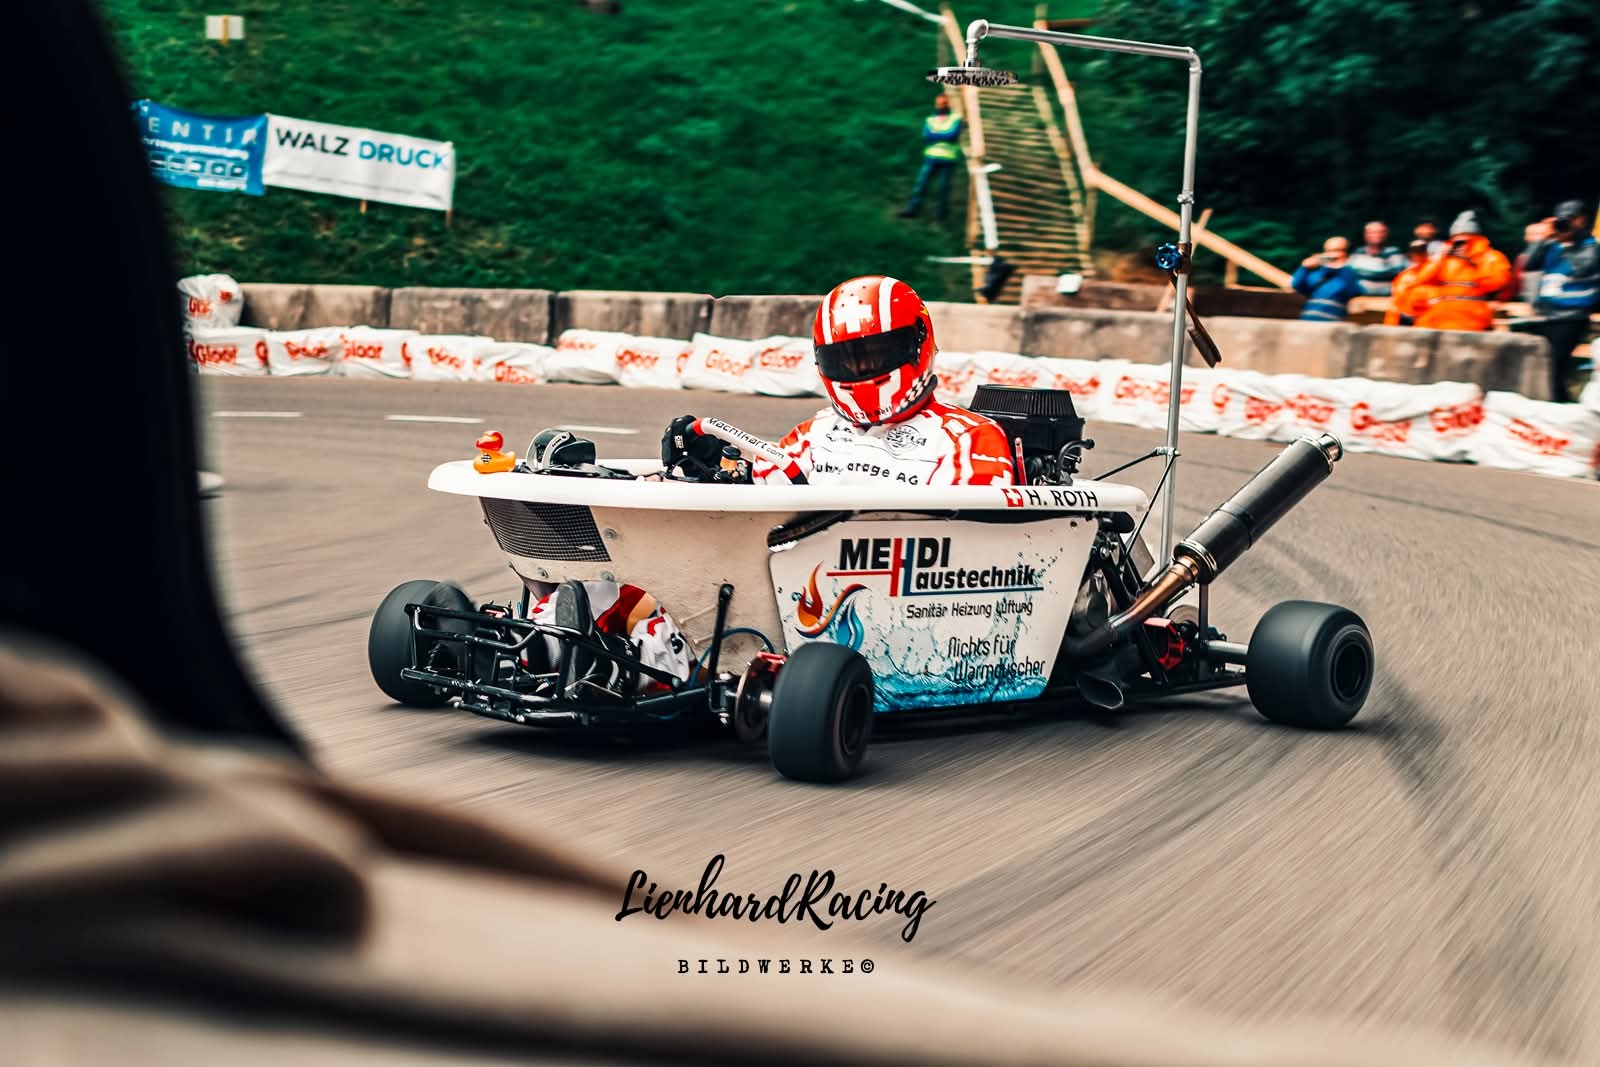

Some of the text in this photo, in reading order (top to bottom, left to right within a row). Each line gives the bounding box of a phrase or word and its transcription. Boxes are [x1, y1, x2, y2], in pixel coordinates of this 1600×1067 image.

[275, 127, 350, 157] WALZ
[358, 141, 449, 169] DRUCK
[896, 472, 919, 486] AG
[1024, 489, 1099, 508] H. ROTH
[906, 600, 1034, 619] Sanitär Heizung Lüftung
[953, 656, 1046, 682] Warmduscher
